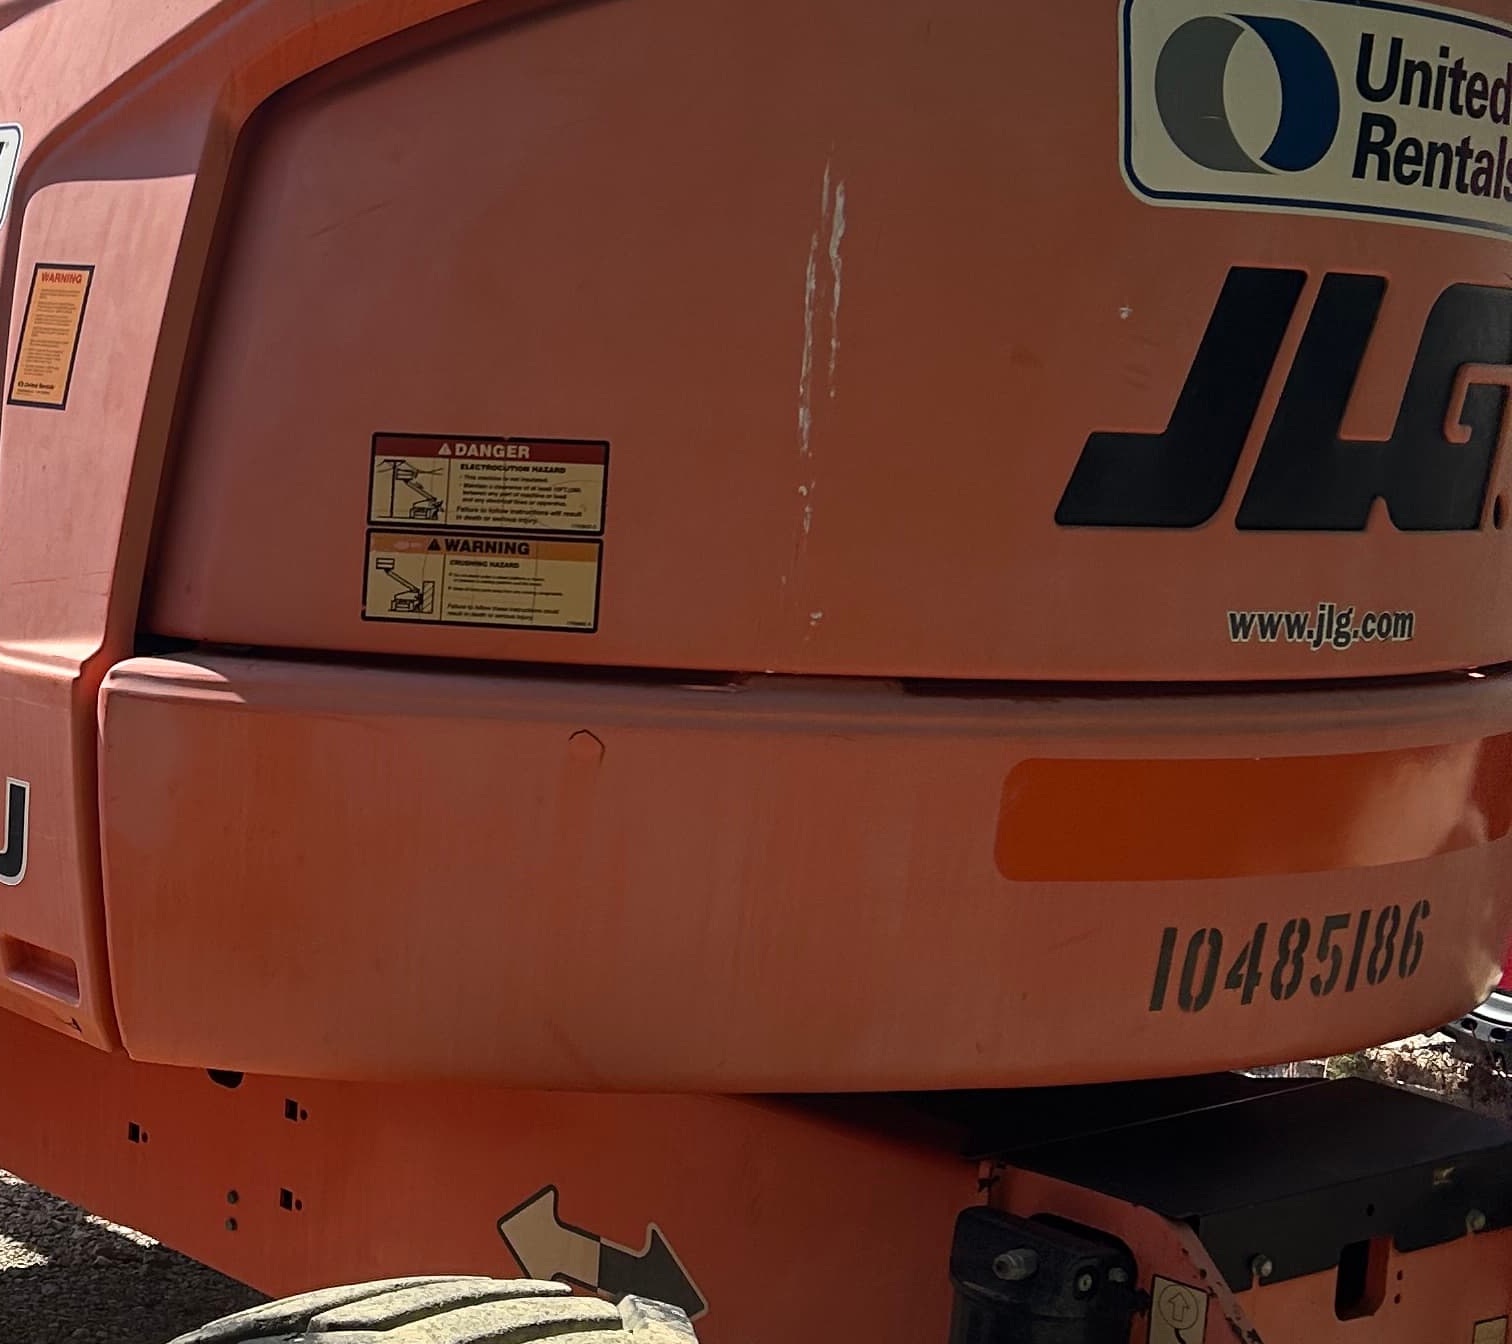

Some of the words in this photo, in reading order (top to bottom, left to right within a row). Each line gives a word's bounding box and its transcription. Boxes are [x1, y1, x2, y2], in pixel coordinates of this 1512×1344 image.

[1356, 32, 1512, 126] United
[41, 271, 82, 284] WARNING
[1054, 266, 1512, 532] JLG
[455, 444, 530, 459] DANGER
[444, 538, 530, 555] WARNING
[1228, 603, 1415, 650] www.jlg.com
[1149, 900, 1430, 1012] 10485186
